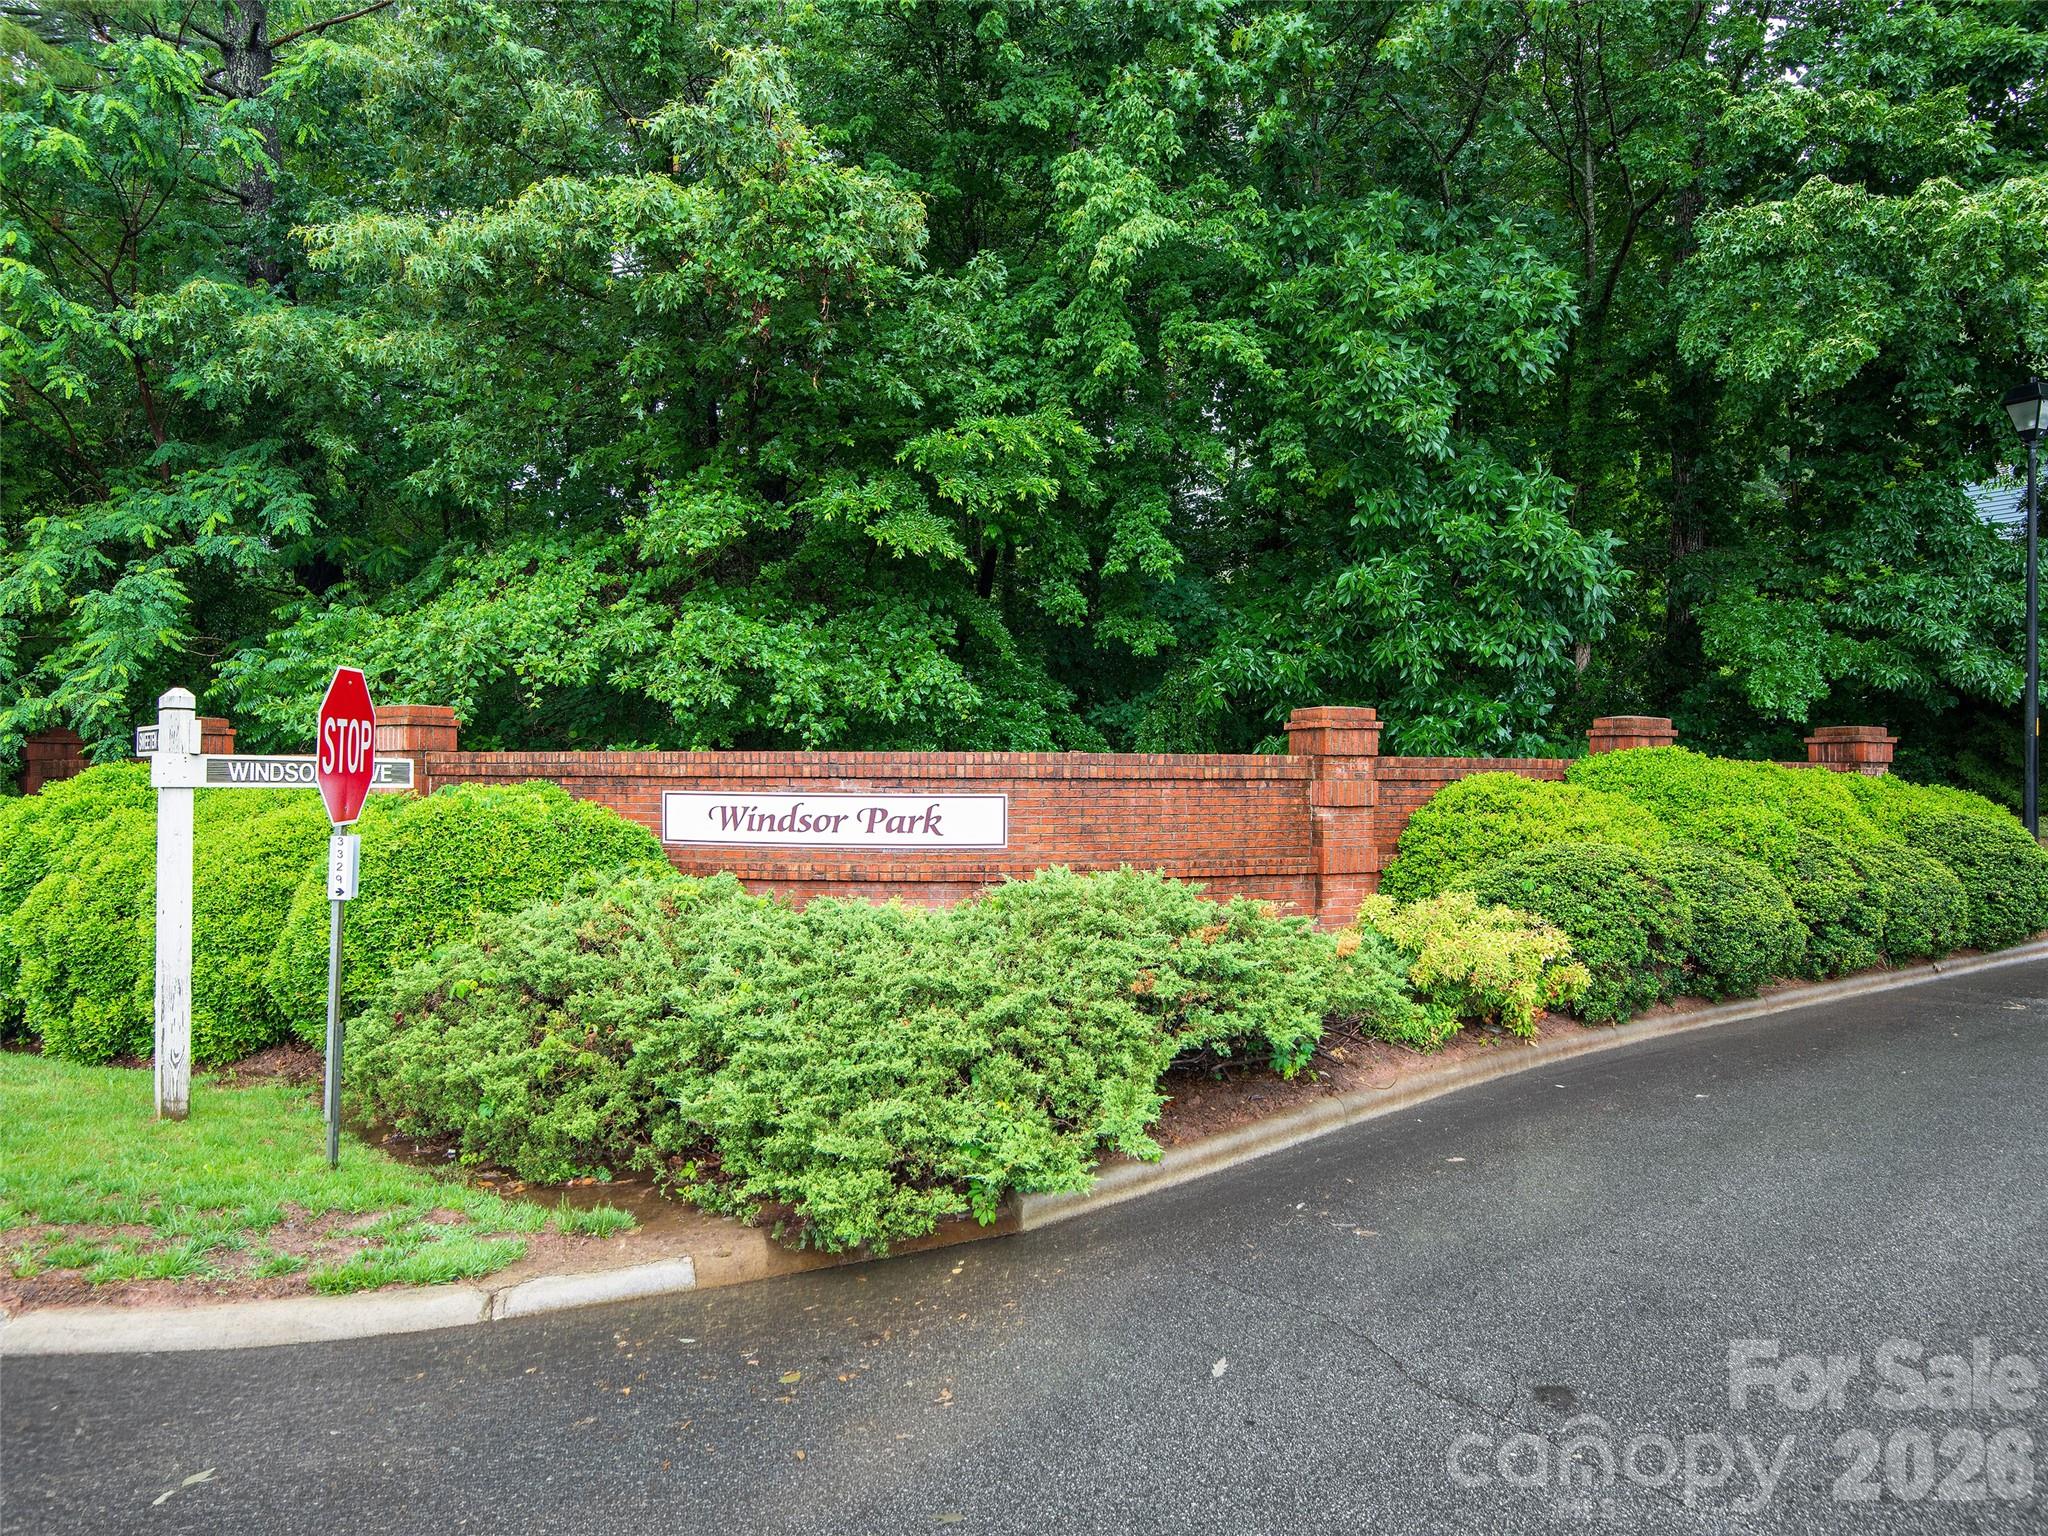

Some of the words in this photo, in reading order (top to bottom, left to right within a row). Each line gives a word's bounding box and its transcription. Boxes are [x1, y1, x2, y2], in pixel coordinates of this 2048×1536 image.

[322, 716, 372, 775] STOP
[228, 762, 317, 782] WINDSO
[708, 803, 849, 834] Windsor
[857, 804, 944, 836] Park
[335, 836, 344, 884] 3329
